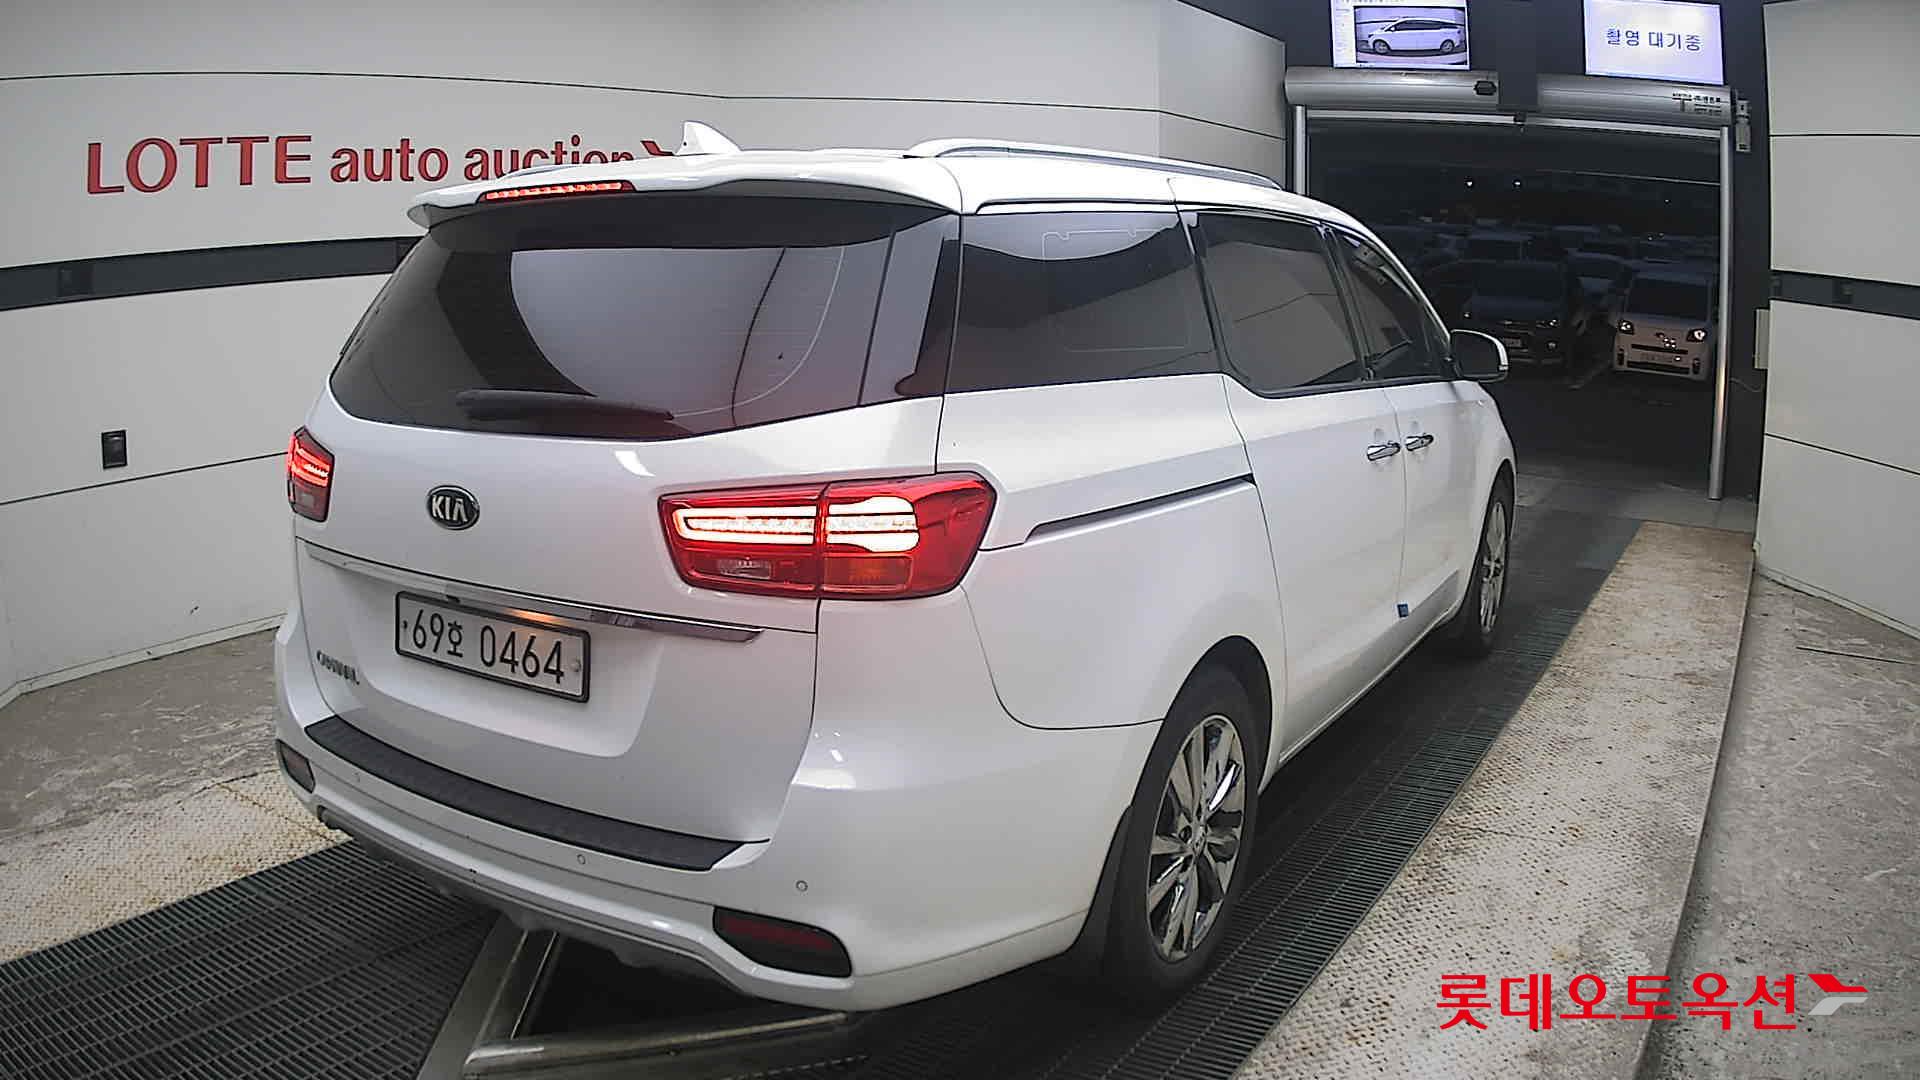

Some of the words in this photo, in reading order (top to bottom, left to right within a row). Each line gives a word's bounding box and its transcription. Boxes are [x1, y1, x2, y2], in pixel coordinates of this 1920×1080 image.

[1607, 28, 1639, 46] 촬영
[1648, 31, 1701, 52] 대기중
[87, 135, 311, 194] LOTTE
[330, 138, 449, 184] auto
[463, 134, 634, 181] aucti
[431, 495, 468, 522] KIA
[480, 625, 564, 684] 0464
